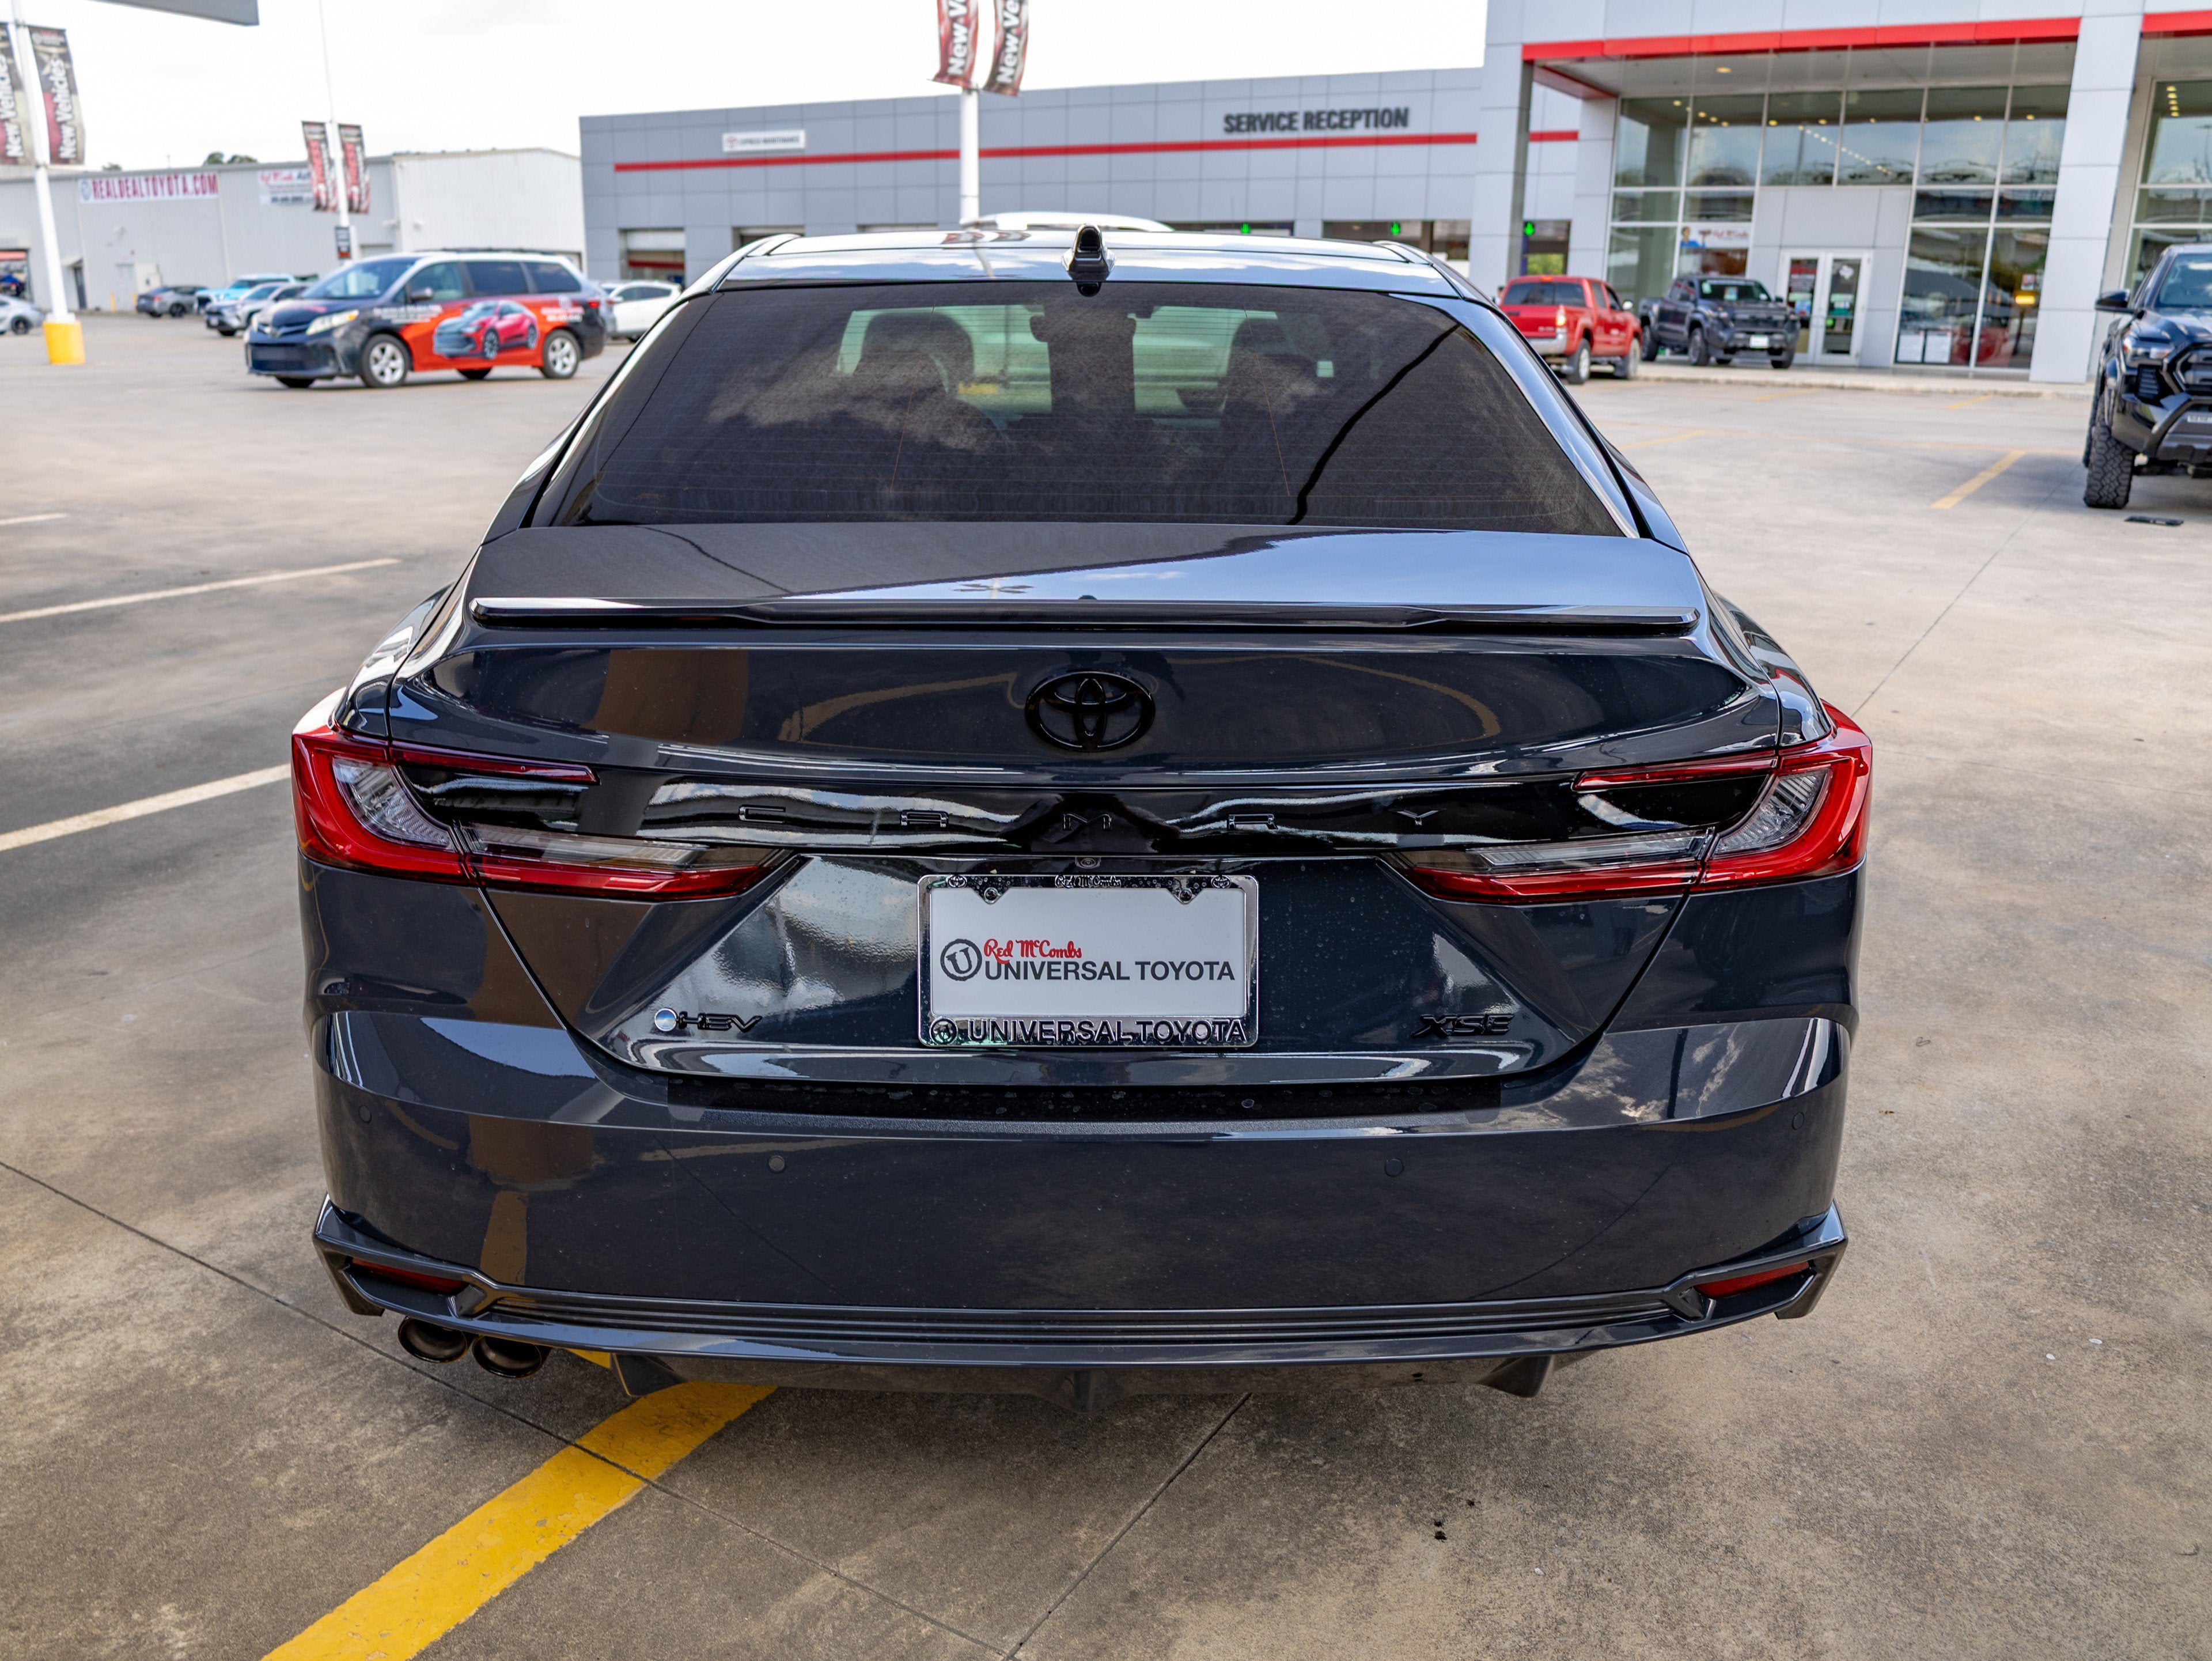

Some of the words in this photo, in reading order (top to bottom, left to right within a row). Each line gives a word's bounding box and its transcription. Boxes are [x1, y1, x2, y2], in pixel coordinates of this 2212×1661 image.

[947, 22, 969, 75] New
[996, 32, 1019, 84] New
[50, 58, 74, 123] Vehicles
[1224, 111, 1300, 133] SERVICE
[1303, 106, 1410, 130] RECEPTION
[5, 122, 25, 157] New
[59, 124, 77, 159] New
[92, 174, 218, 199] REALDEALTOYOTA.COM
[983, 939, 1013, 964] Red
[1016, 940, 1082, 958] McCombs
[985, 961, 1130, 981] UNIVERSAL
[1135, 961, 1235, 981] TOYOTA
[679, 1011, 763, 1033] HEV
[968, 1019, 1132, 1043] UNIVERSAL
[1135, 1019, 1247, 1043] TOYOTA
[1411, 1013, 1515, 1038] XSE
